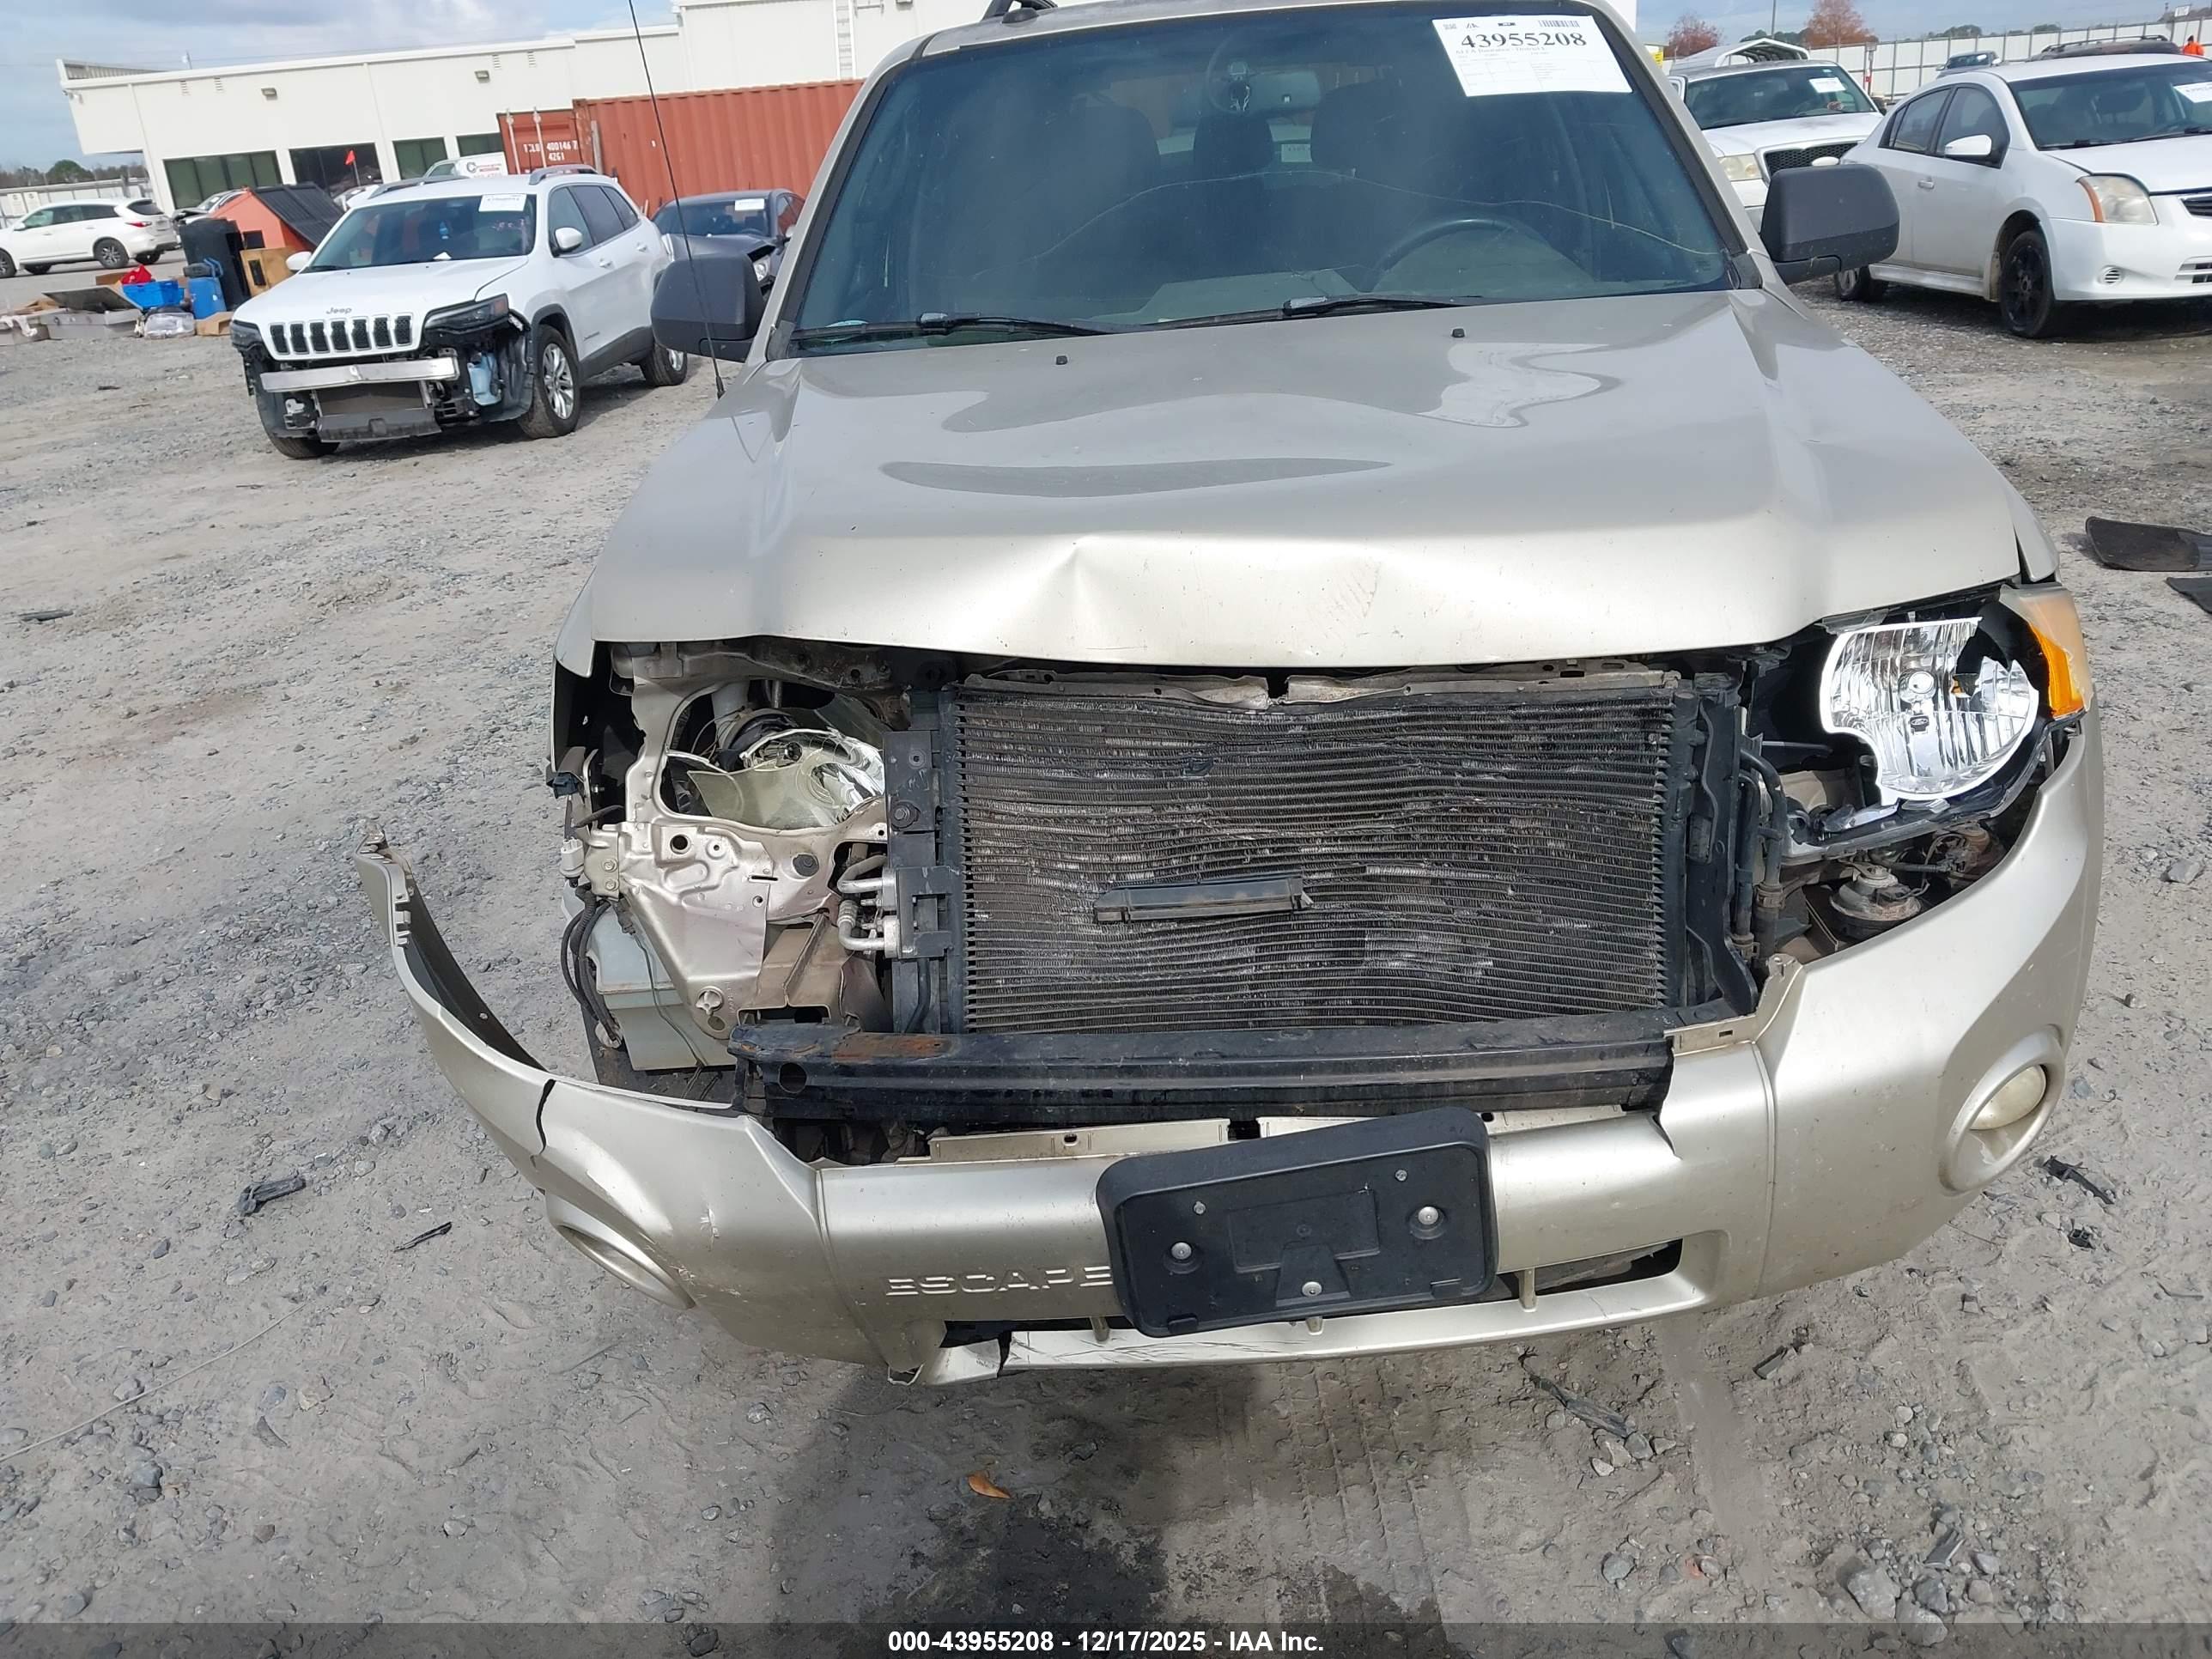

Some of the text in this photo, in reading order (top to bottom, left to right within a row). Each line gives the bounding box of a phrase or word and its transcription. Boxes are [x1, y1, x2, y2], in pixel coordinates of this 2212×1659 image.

[1461, 32, 1587, 48] 43955208
[548, 152, 565, 161] 4261
[325, 307, 352, 315] Jeep
[885, 1265, 1114, 1297] ESCAPE
